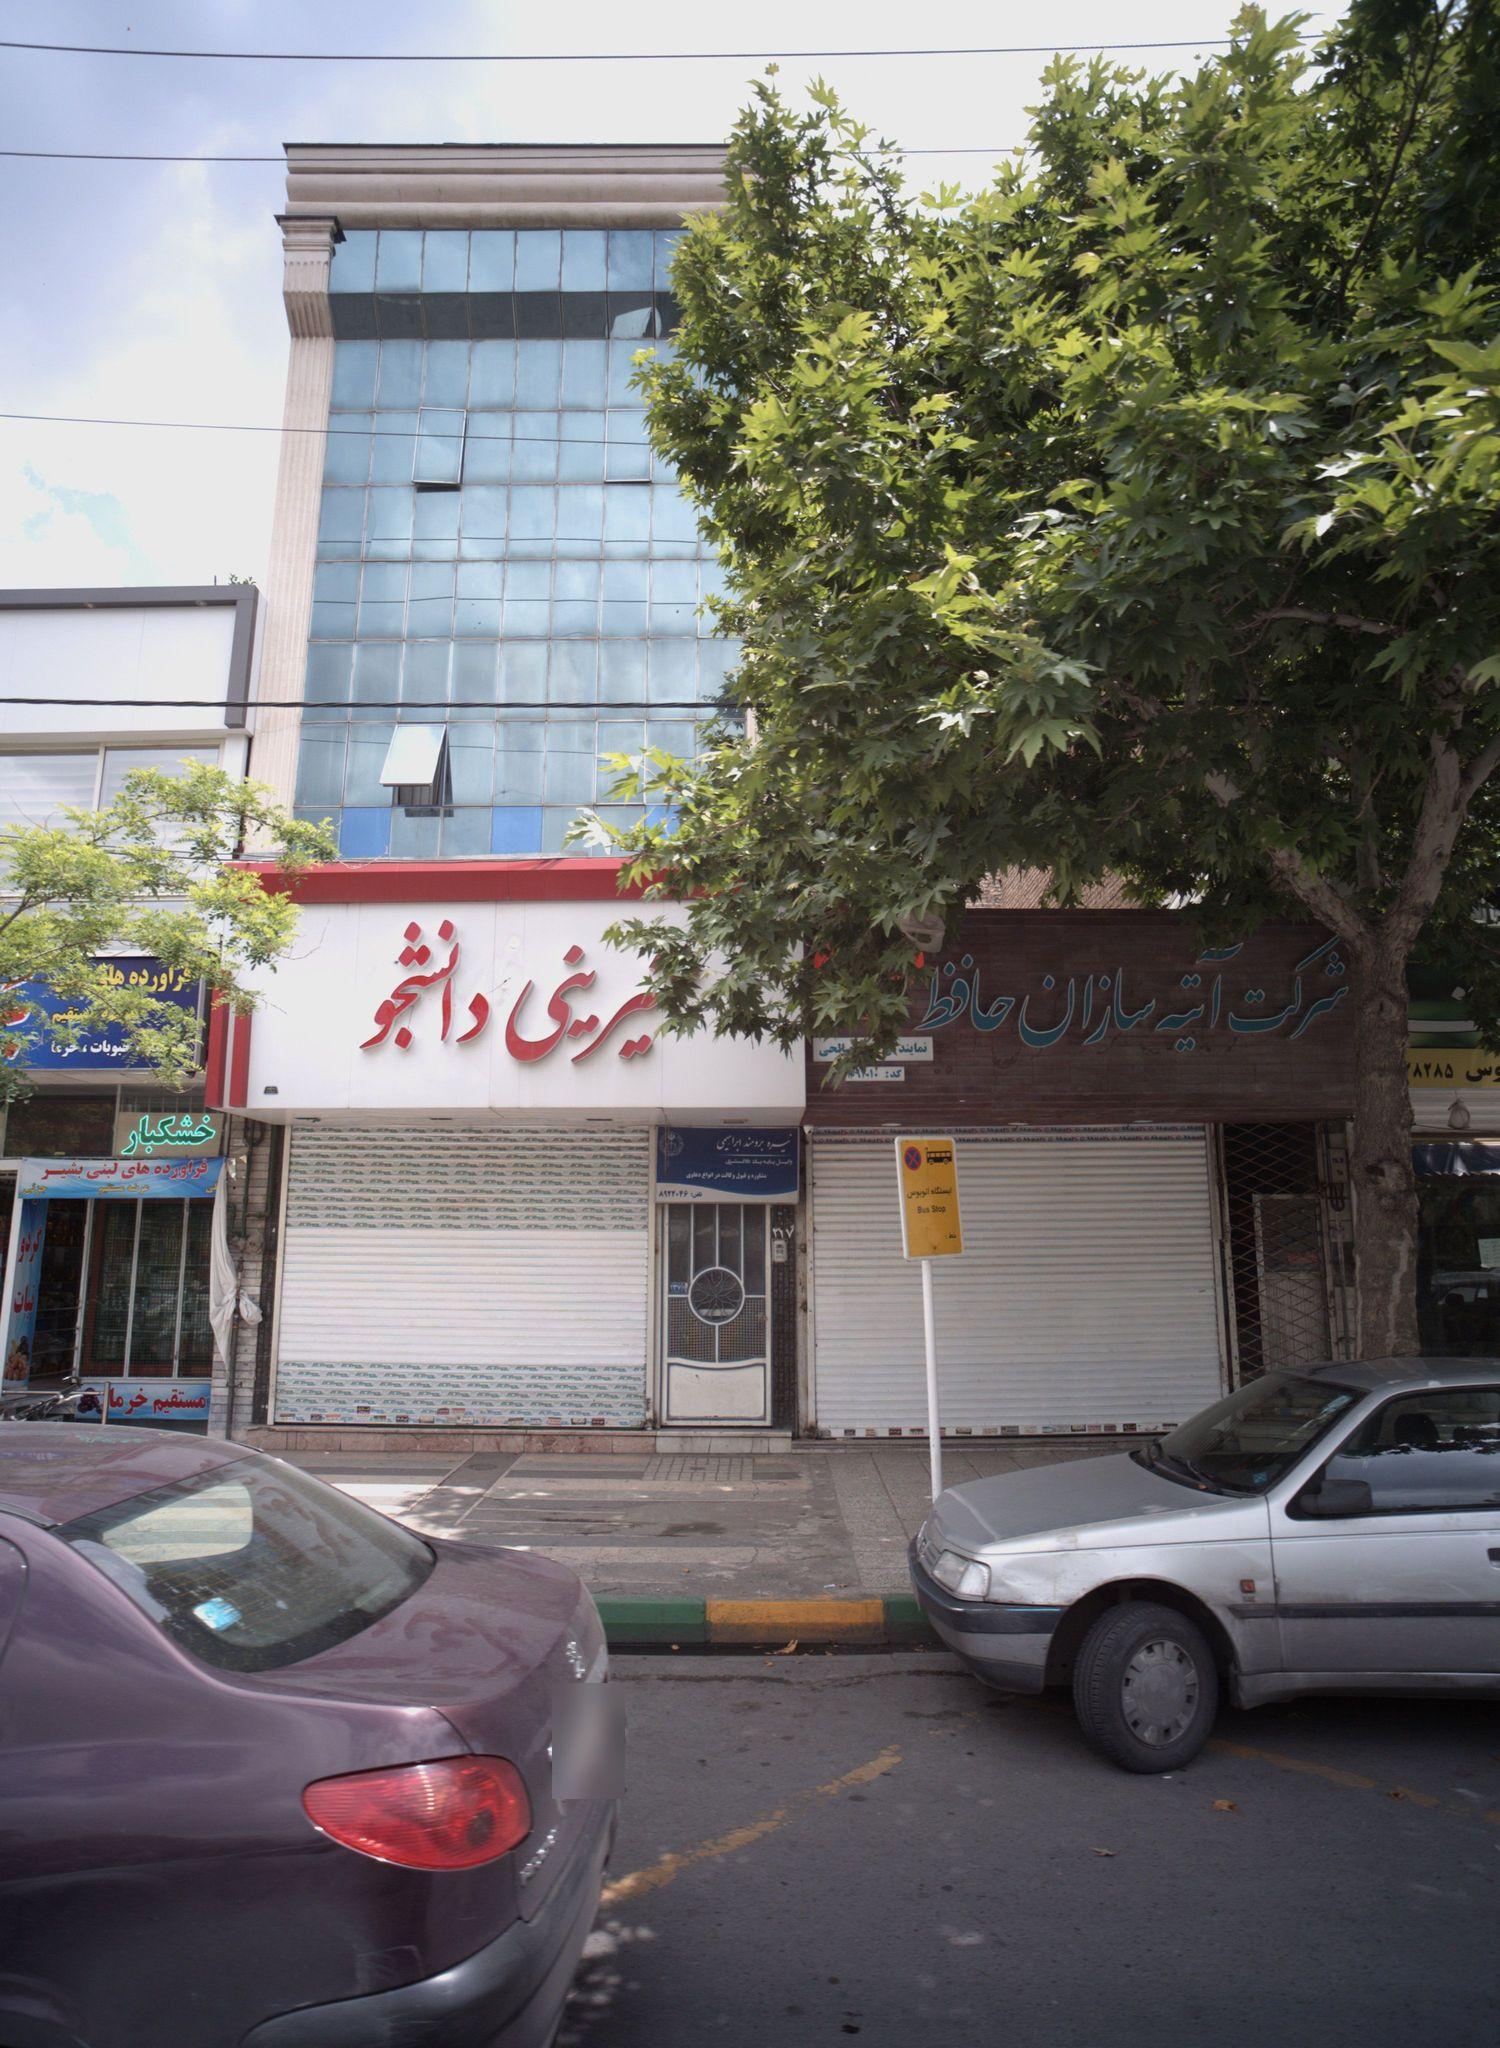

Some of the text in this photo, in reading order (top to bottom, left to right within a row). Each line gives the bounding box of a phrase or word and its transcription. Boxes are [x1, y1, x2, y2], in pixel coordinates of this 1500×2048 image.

[359, 919, 490, 1050] دانشجو
[505, 944, 663, 1064] یرینی
[914, 954, 1016, 1032] حافظ
[1155, 942, 1244, 1052] آتیه
[1229, 935, 1349, 1041] شرکت
[1018, 967, 1156, 1049] سازان
[121, 1114, 217, 1155] خشکبار
[86, 1163, 119, 1179] لبنی
[121, 1162, 150, 1179] های
[154, 1158, 209, 1180] فراورده
[917, 1205, 946, 1214] Bus Stop
[18, 1227, 43, 1263] گردو
[109, 1387, 206, 1415] مستقیم خرما
